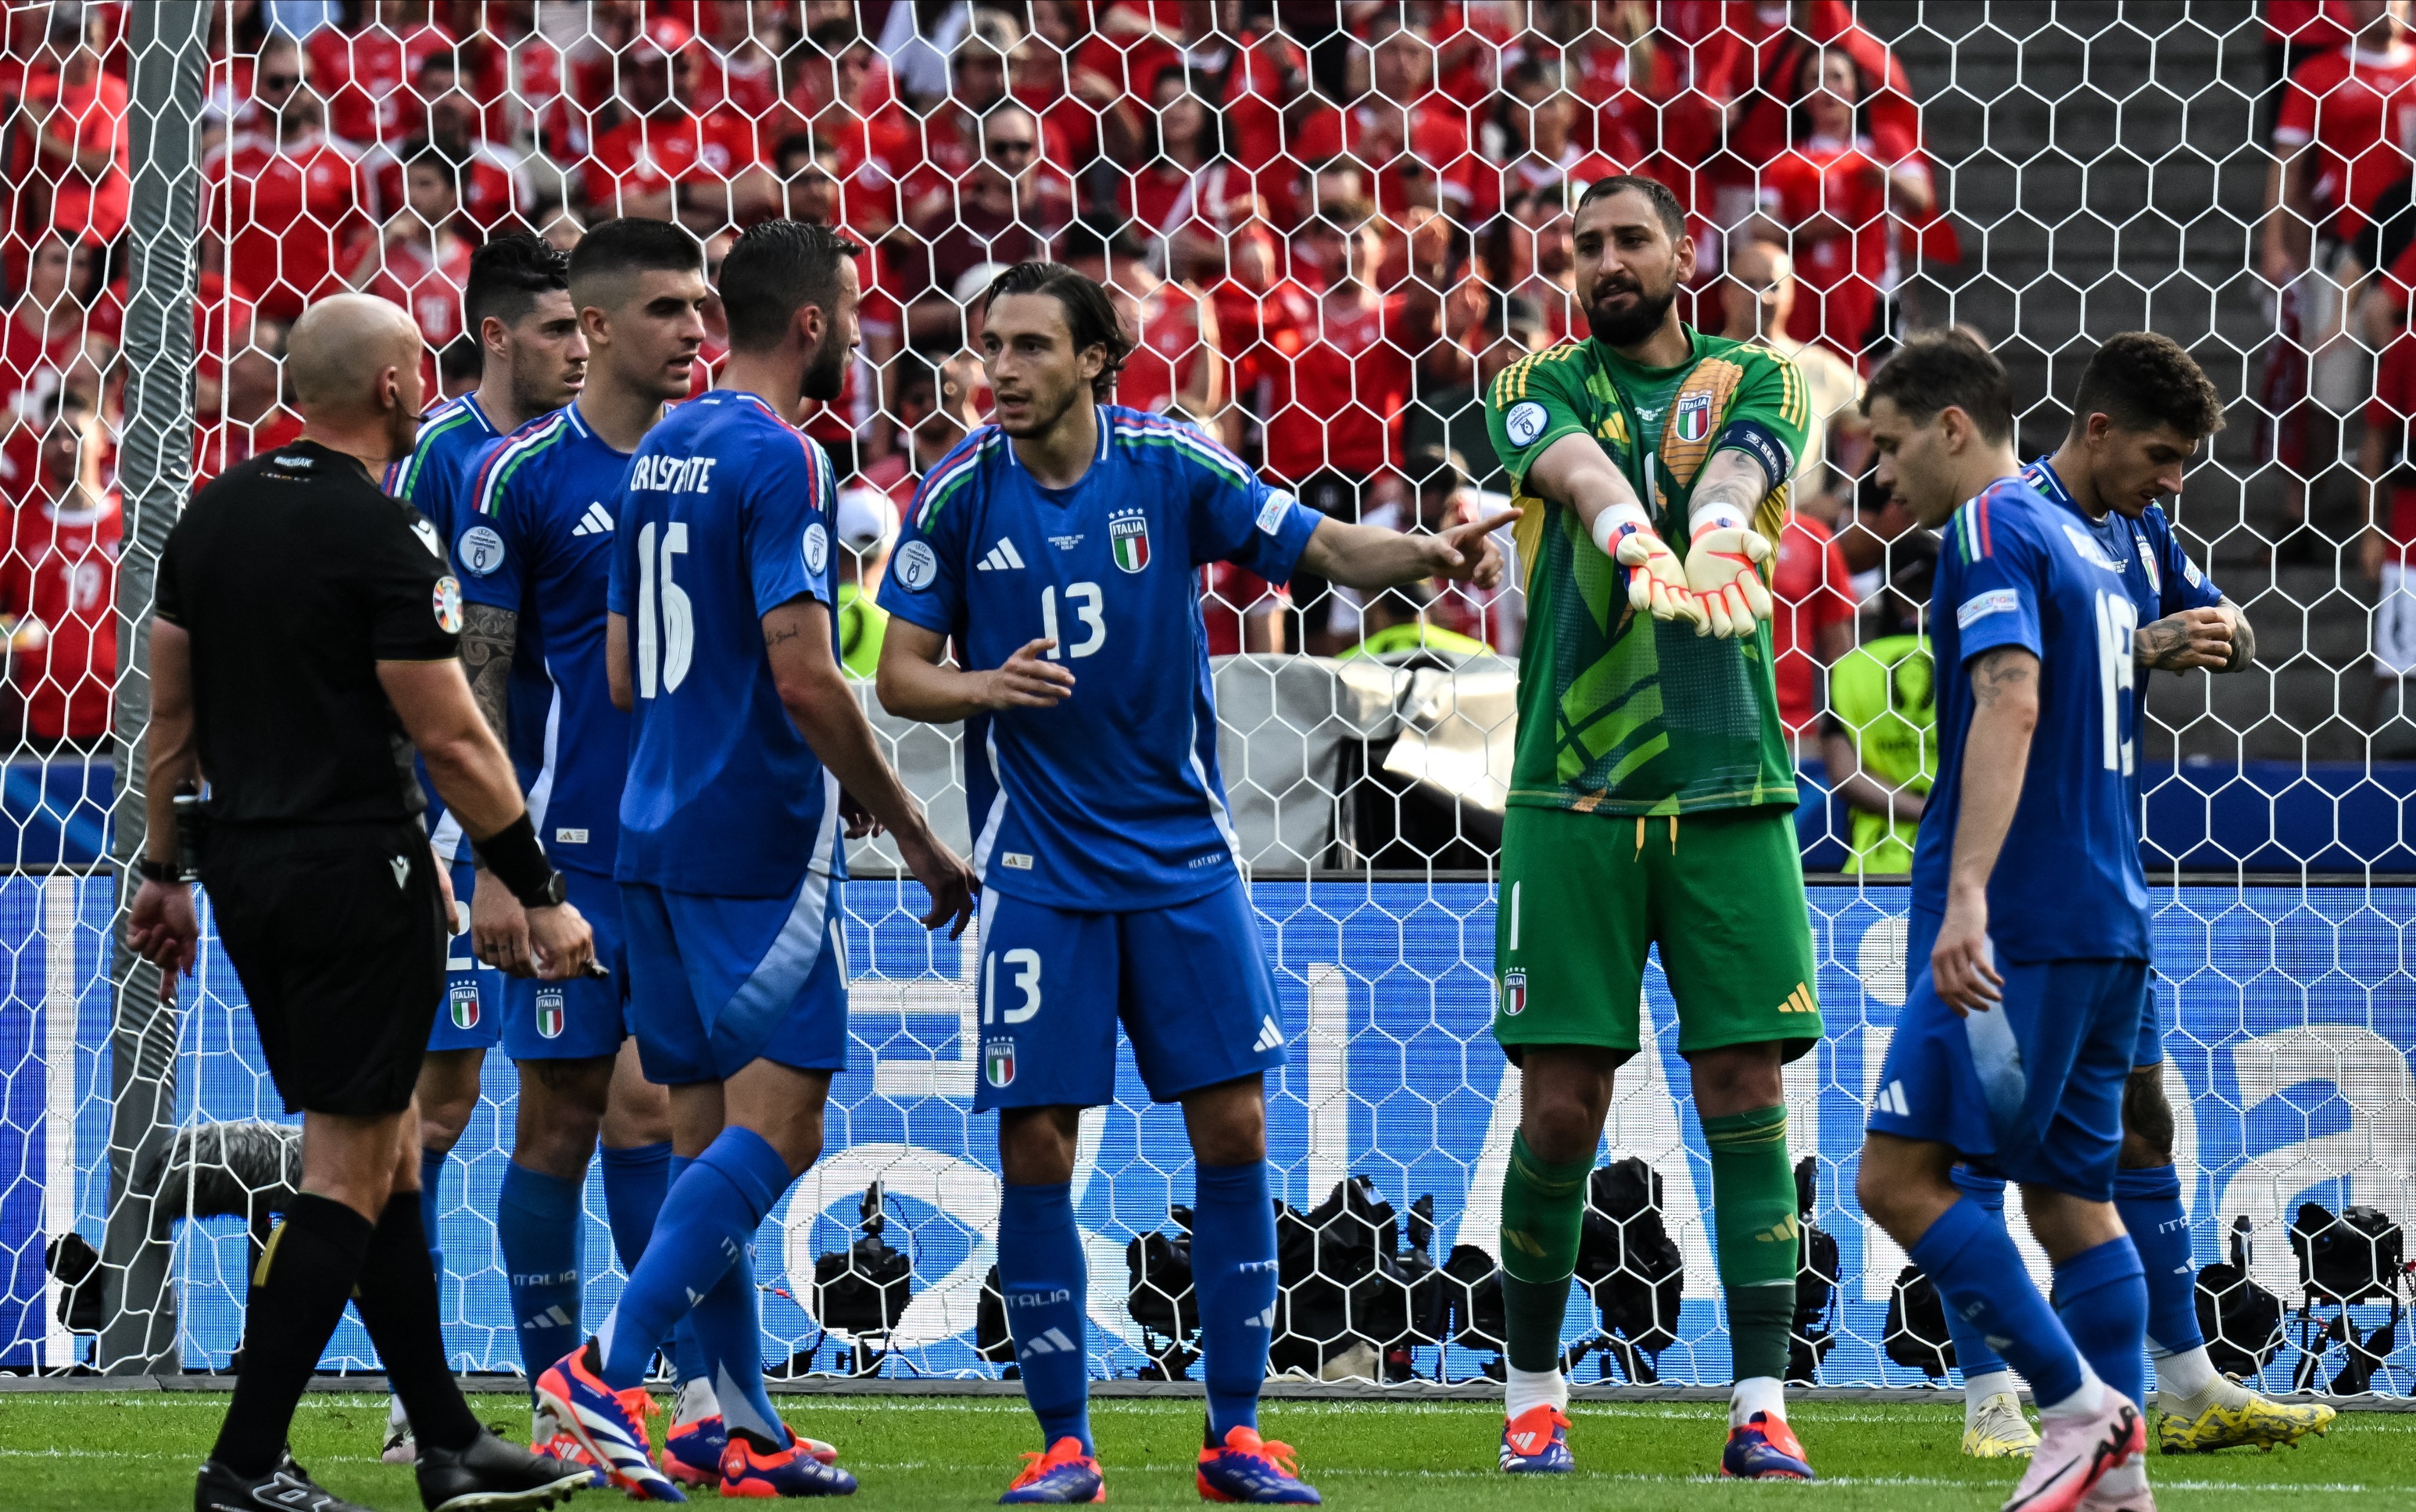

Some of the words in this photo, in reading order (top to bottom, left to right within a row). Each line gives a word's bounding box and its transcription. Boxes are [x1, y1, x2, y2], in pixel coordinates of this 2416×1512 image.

[1681, 397, 1706, 411] ITALIA
[630, 455, 718, 494] CRISTATE
[1112, 521, 1144, 535] ITALIA
[1042, 581, 1107, 659] 13
[1188, 853, 1220, 869] HEAT.RDY
[1510, 880, 1520, 951] 1
[984, 948, 1041, 1025] 13
[1505, 977, 1524, 987] ITALIA
[452, 990, 476, 1000] ITALIA
[538, 998, 560, 1008] ITALIA
[987, 1047, 1012, 1057] ITALIA
[1005, 1289, 1069, 1308] TALIA
